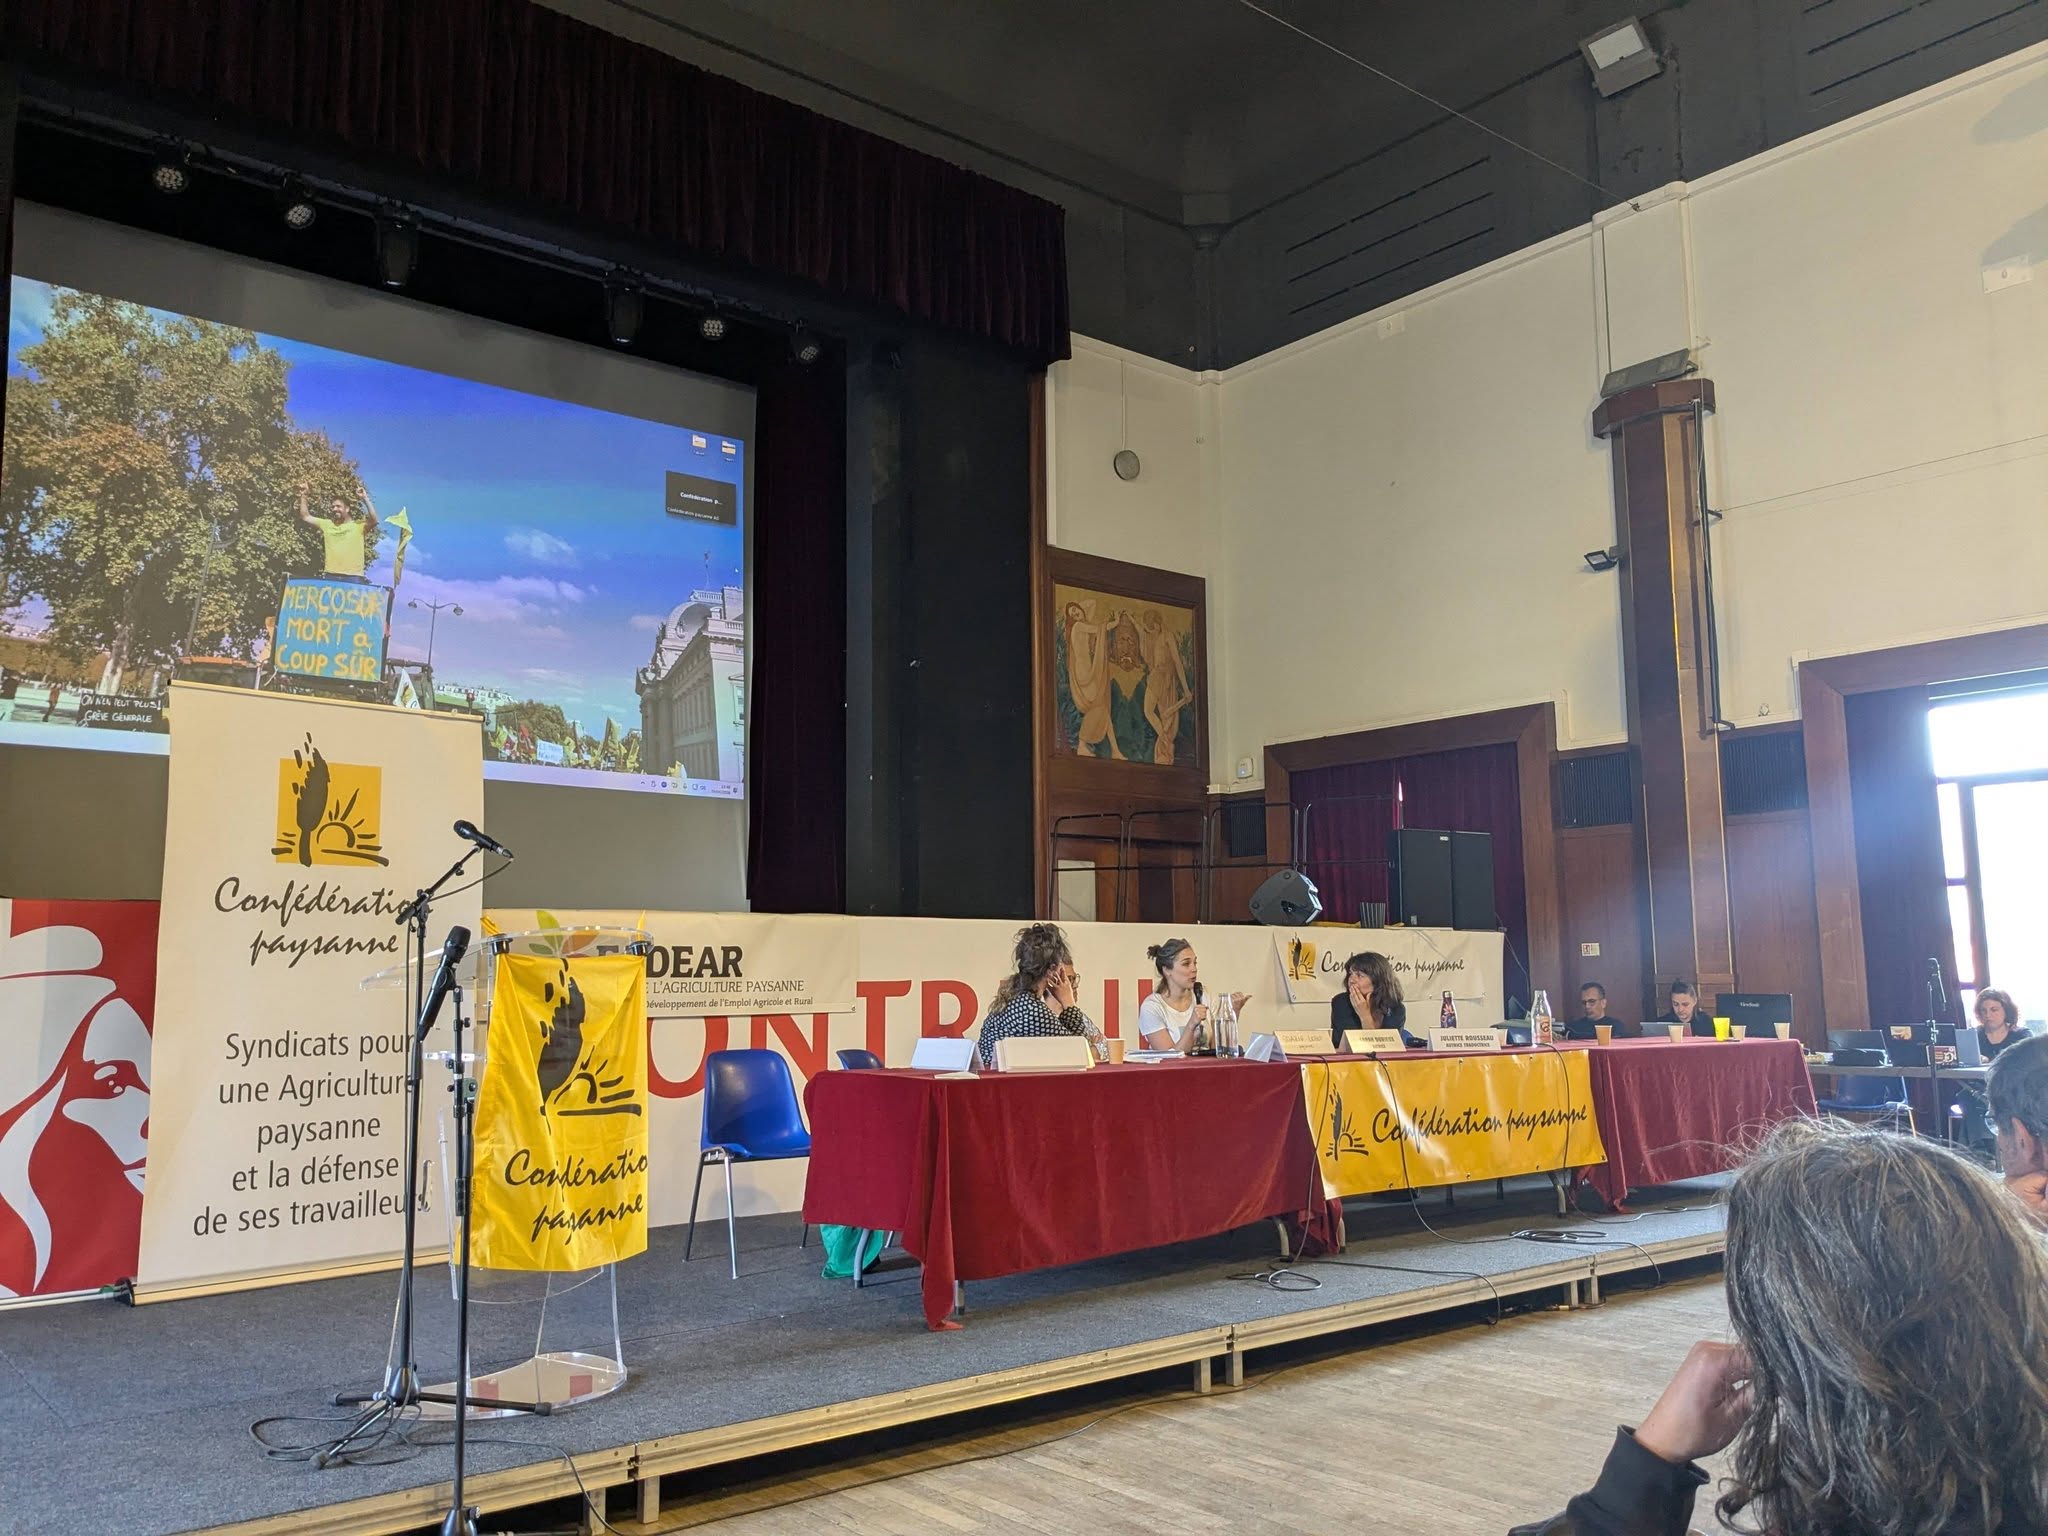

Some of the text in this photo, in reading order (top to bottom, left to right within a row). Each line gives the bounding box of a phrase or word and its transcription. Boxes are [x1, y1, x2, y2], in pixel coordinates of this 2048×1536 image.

[287, 617, 350, 646] MORT
[275, 644, 377, 680] COUP SÛR
[250, 930, 399, 968] paysanne
[1415, 958, 1465, 980] paysanne
[653, 980, 742, 994] L'AGRICULTURE
[746, 979, 804, 993] PAYSANNE
[709, 999, 719, 1008] de
[720, 998, 751, 1009] l'Emploi
[753, 998, 783, 1008] Agricole
[785, 998, 792, 1006] et
[794, 997, 813, 1005] Rural
[225, 1030, 349, 1067] Syndicats
[219, 1081, 269, 1104] une
[257, 1117, 381, 1153] paysanne
[1372, 1104, 1588, 1154] Confédération paysanne
[232, 1154, 399, 1191] et la défense
[193, 1206, 227, 1236] de
[238, 1206, 280, 1232] ses
